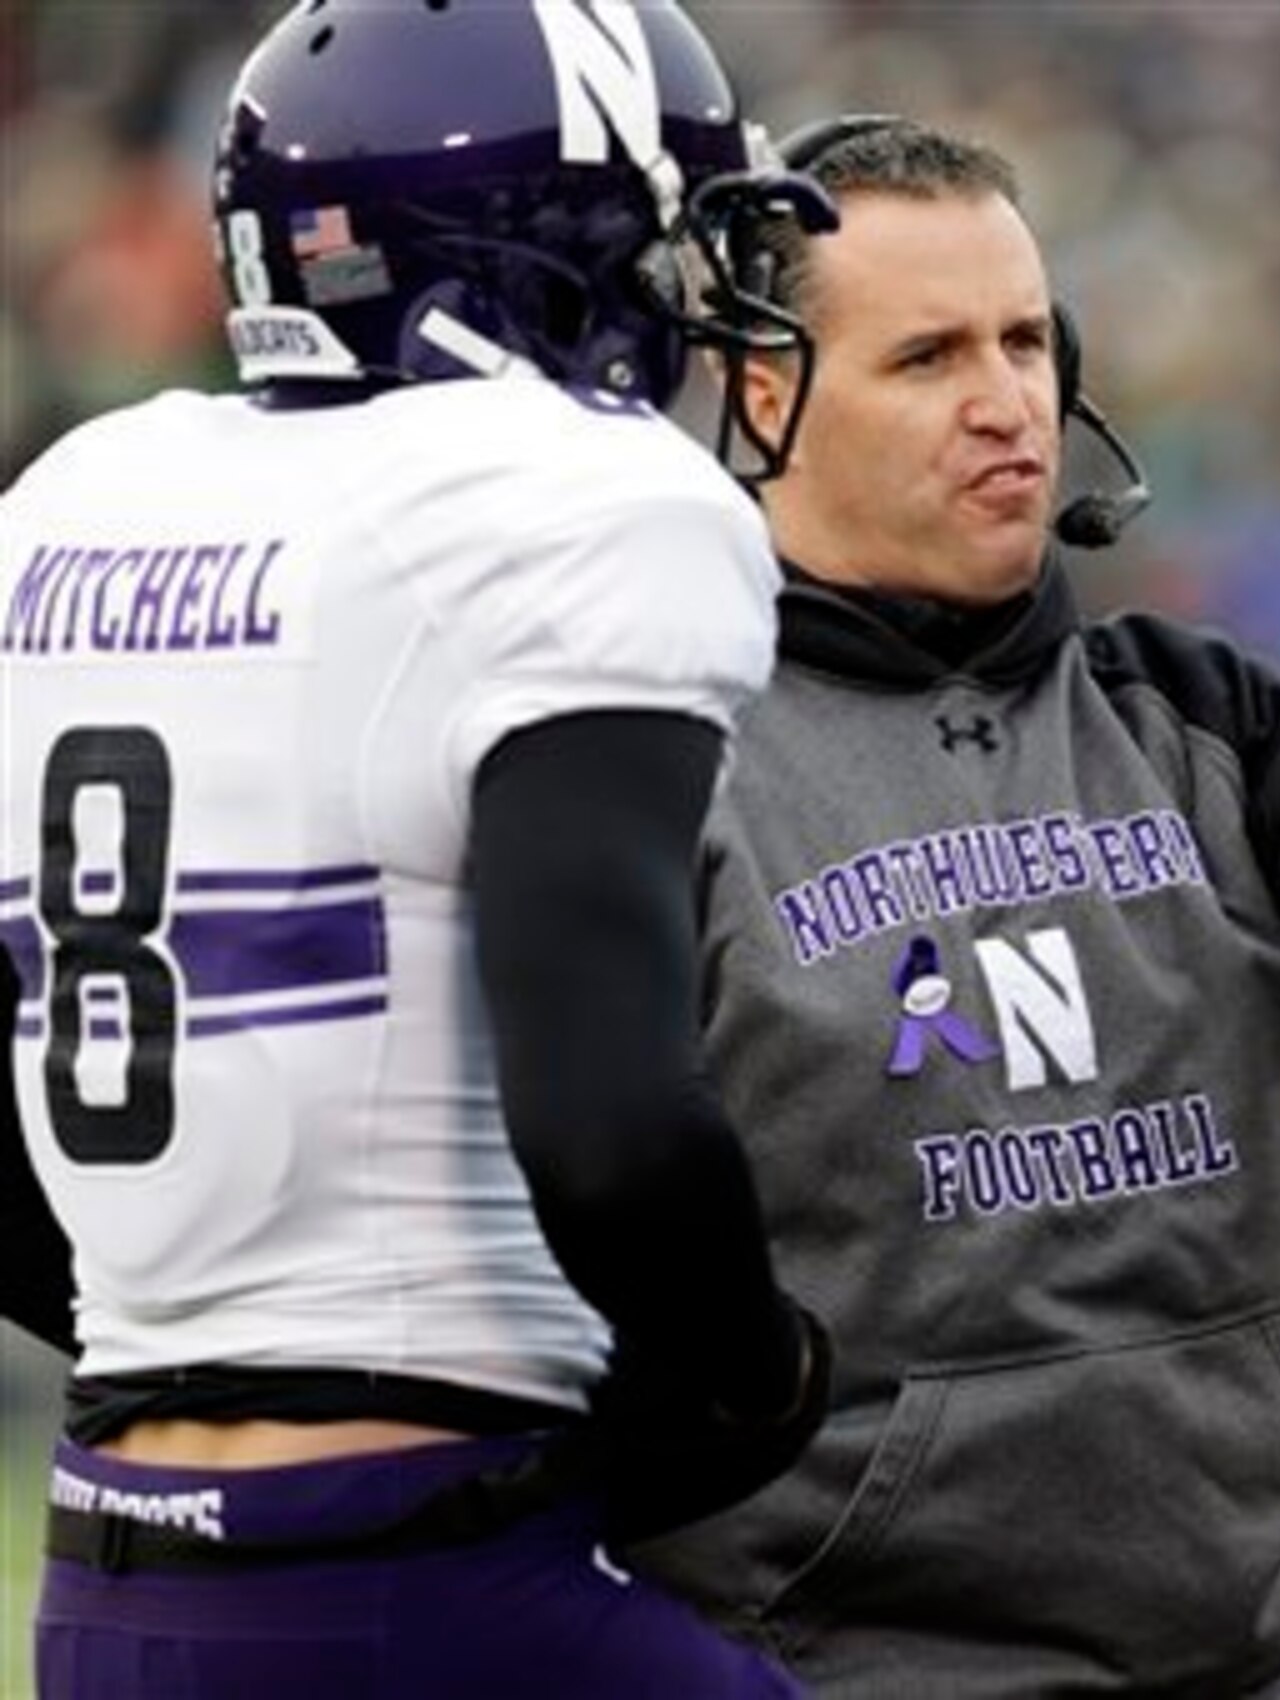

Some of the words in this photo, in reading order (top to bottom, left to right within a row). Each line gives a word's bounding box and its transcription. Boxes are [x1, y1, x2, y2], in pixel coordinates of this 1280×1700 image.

[533, 0, 664, 166] N
[2, 539, 284, 654] MITCHELL
[38, 725, 177, 1164] 8
[974, 928, 1096, 1092] N
[916, 1094, 1238, 1221] FOOTBALL
